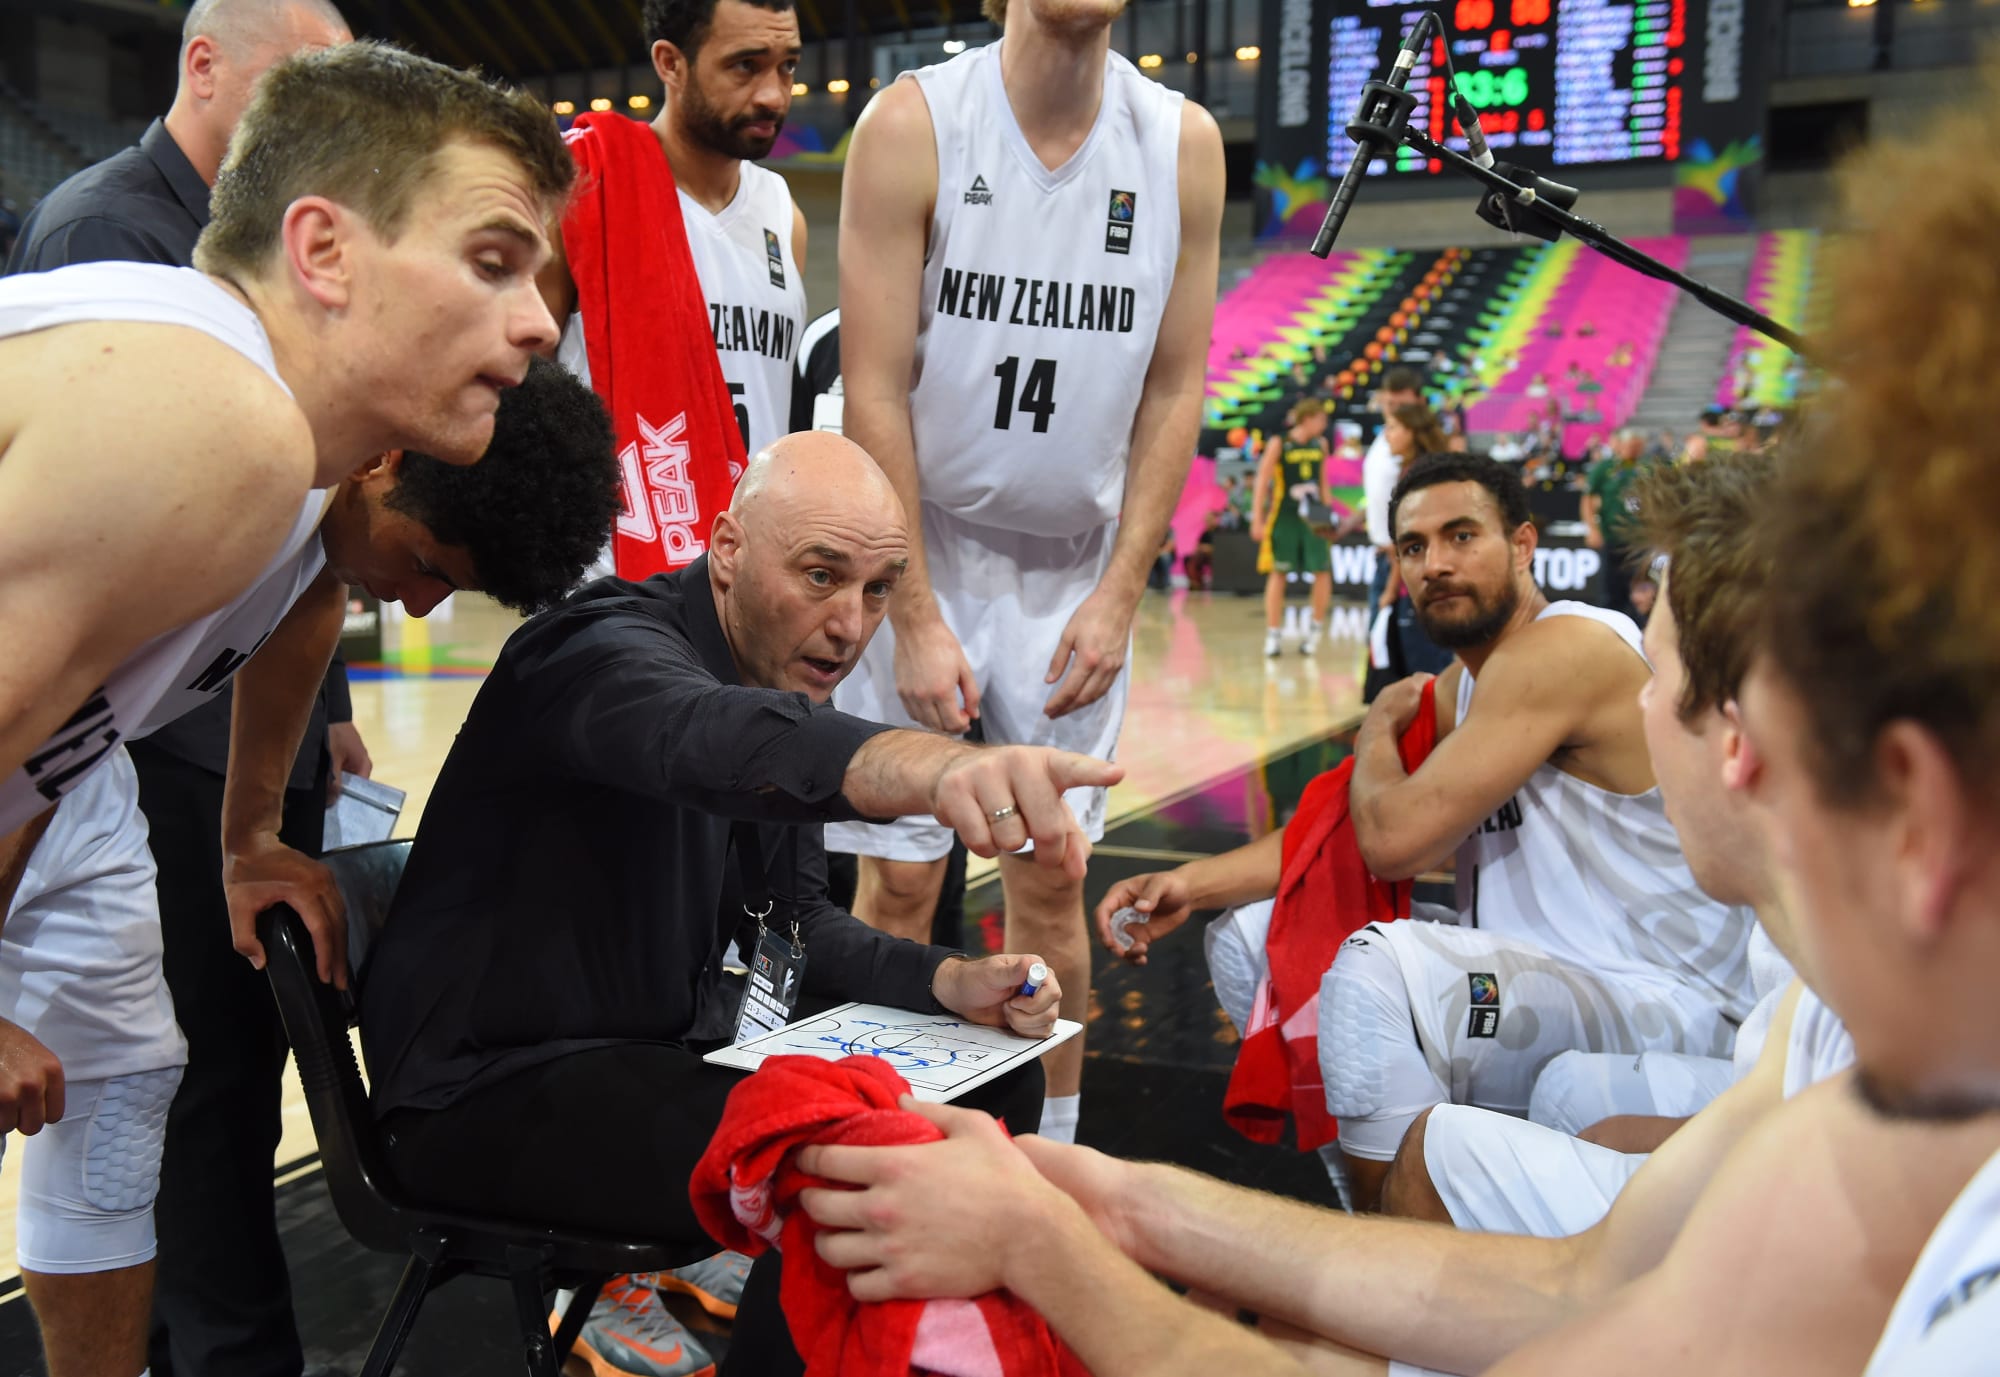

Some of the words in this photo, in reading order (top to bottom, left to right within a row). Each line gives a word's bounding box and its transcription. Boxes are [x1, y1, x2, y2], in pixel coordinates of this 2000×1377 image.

[964, 192, 994, 206] PEAK
[937, 267, 1005, 322] NEW
[1009, 277, 1136, 333] ZEALAND
[710, 303, 794, 363] ZEALAND
[993, 356, 1058, 433] 14
[636, 410, 706, 566] PEAK
[1481, 1011, 1497, 1035] FIBA
